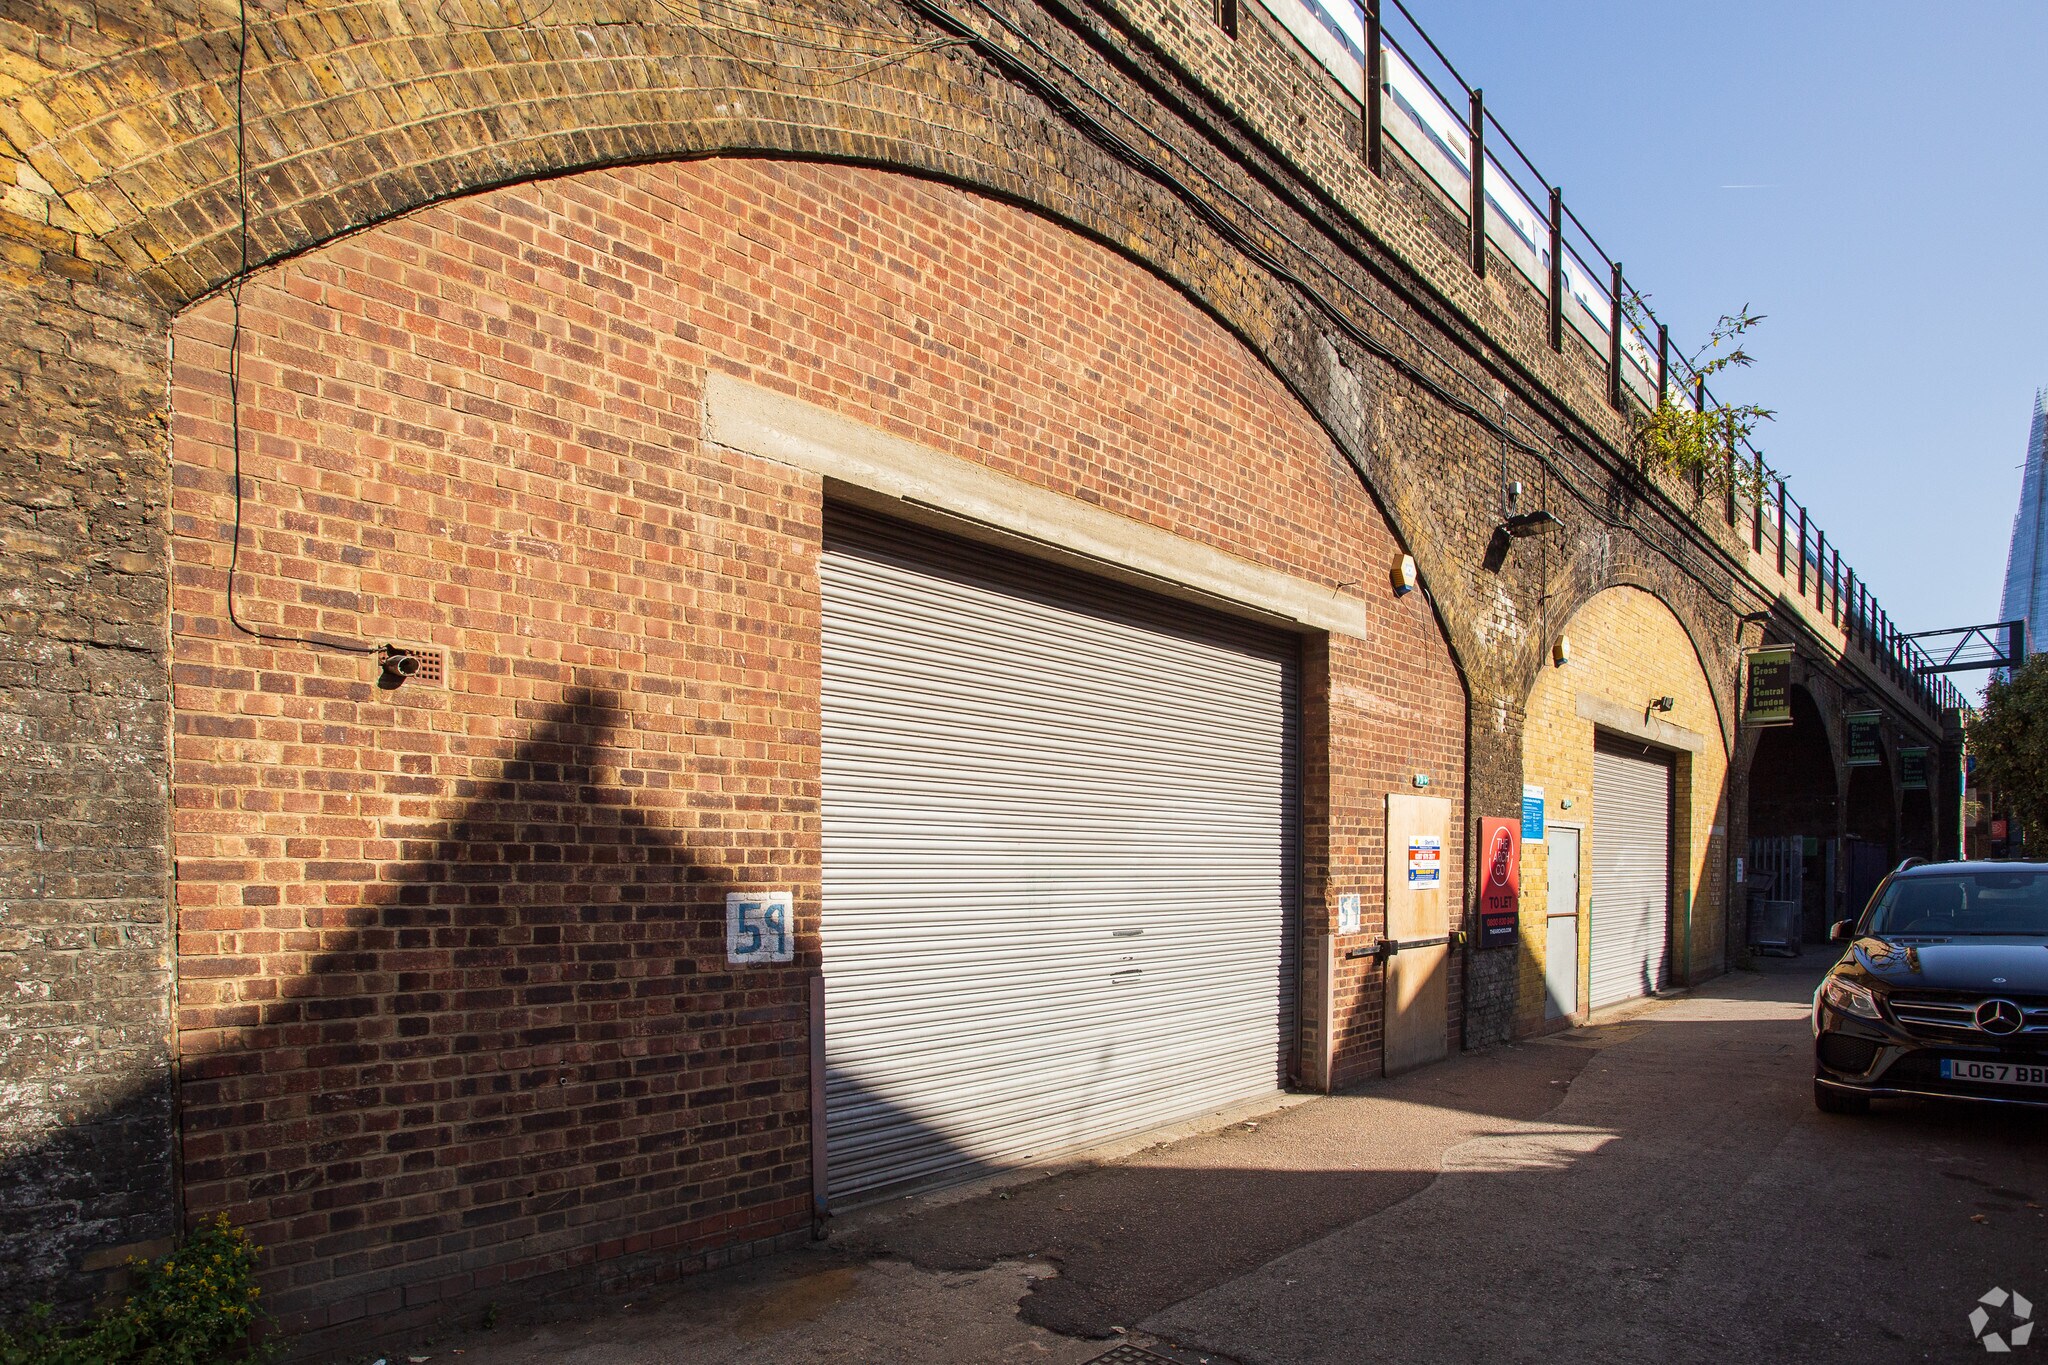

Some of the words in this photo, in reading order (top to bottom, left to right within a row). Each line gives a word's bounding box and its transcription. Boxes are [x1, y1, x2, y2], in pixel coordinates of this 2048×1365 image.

[1753, 665, 1778, 676] Cross
[1753, 676, 1765, 686] Fit
[1753, 687, 1784, 697] Central
[1753, 698, 1784, 708] London
[1496, 837, 1509, 850] THE
[1493, 850, 1511, 863] ARCH
[1495, 863, 1506, 876] CO
[1489, 896, 1499, 909] TO
[1500, 895, 1513, 909] LET
[734, 903, 785, 955] 59
[2015, 1066, 2048, 1084] BB
